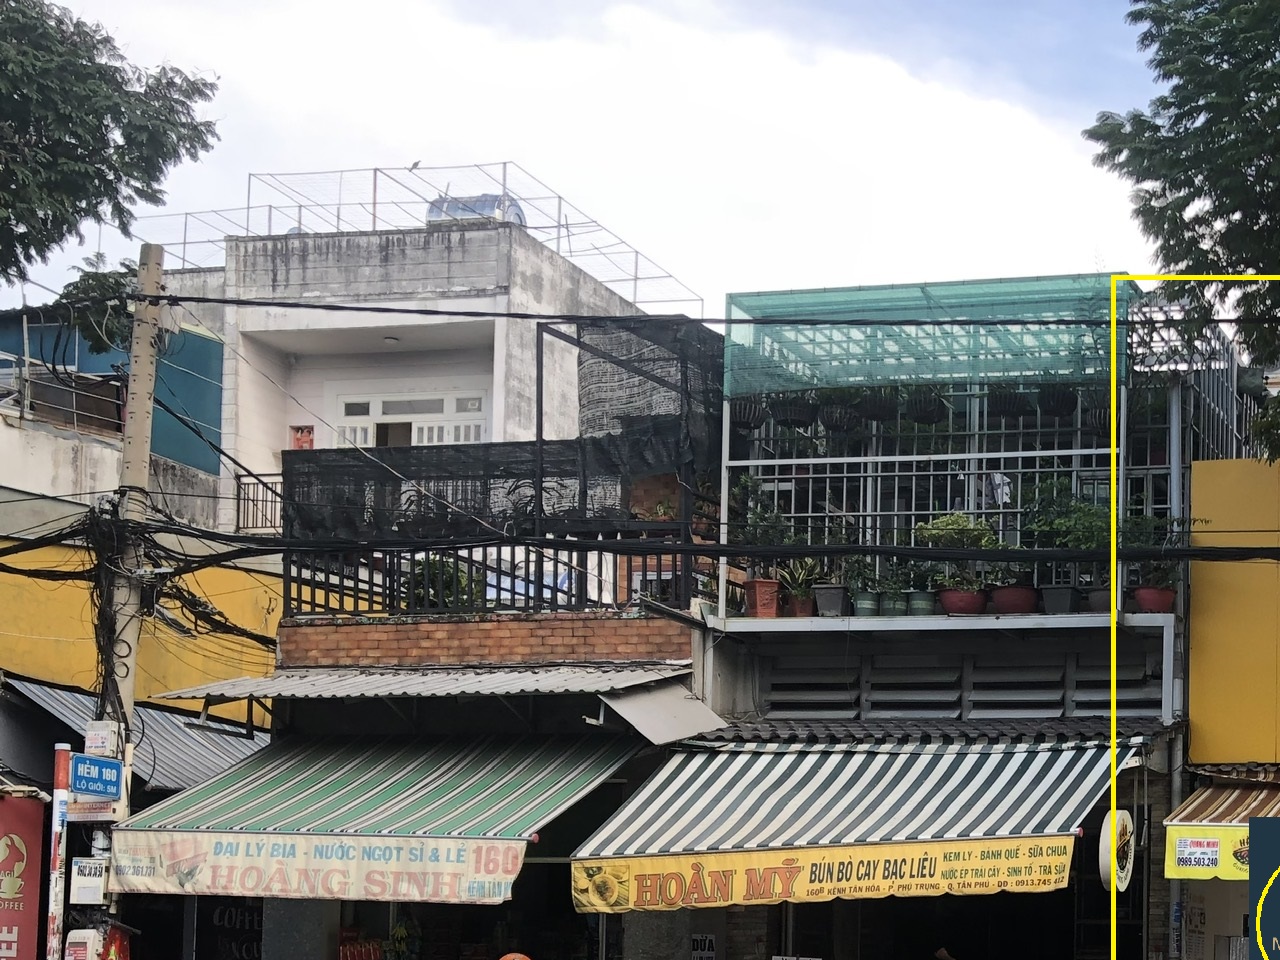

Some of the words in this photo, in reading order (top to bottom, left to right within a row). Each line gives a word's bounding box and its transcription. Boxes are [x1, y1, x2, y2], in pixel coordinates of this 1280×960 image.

[77, 760, 99, 779] HẺM
[102, 768, 117, 782] 160
[106, 785, 117, 793] 5M
[213, 841, 239, 859] ĐẠI
[245, 838, 266, 858] LÝ
[270, 842, 296, 858] BIA
[313, 842, 356, 861] NƯỚC
[361, 845, 403, 865] NGỌT
[428, 847, 440, 863] &
[446, 842, 466, 864] LẺ
[472, 845, 519, 876] 160
[943, 851, 960, 862] KEM
[962, 850, 973, 860] LY
[980, 847, 1002, 860] BÁNH
[1004, 844, 1021, 860] QUẾ
[1028, 845, 1044, 858] SỮA
[1046, 845, 1068, 857] CHUA
[960, 867, 969, 879] ÉP
[970, 865, 985, 878] TRÁI
[987, 866, 1001, 877] CÂY
[1006, 866, 1021, 877] SINH
[1024, 862, 1034, 876] TỐ
[1039, 862, 1052, 876] TRÀ
[1176, 857, 1218, 867] 0989.503.240
[208, 860, 351, 898] HOÀNG
[363, 869, 464, 899] SINH
[634, 861, 735, 907] HOÀN
[743, 858, 805, 901] MỸ
[809, 856, 834, 884] BÚN
[836, 855, 853, 882] BÒ
[856, 859, 880, 881] CAY
[882, 858, 907, 885] BẠC
[909, 851, 937, 879] LIÊU
[957, 881, 972, 889] TÂN
